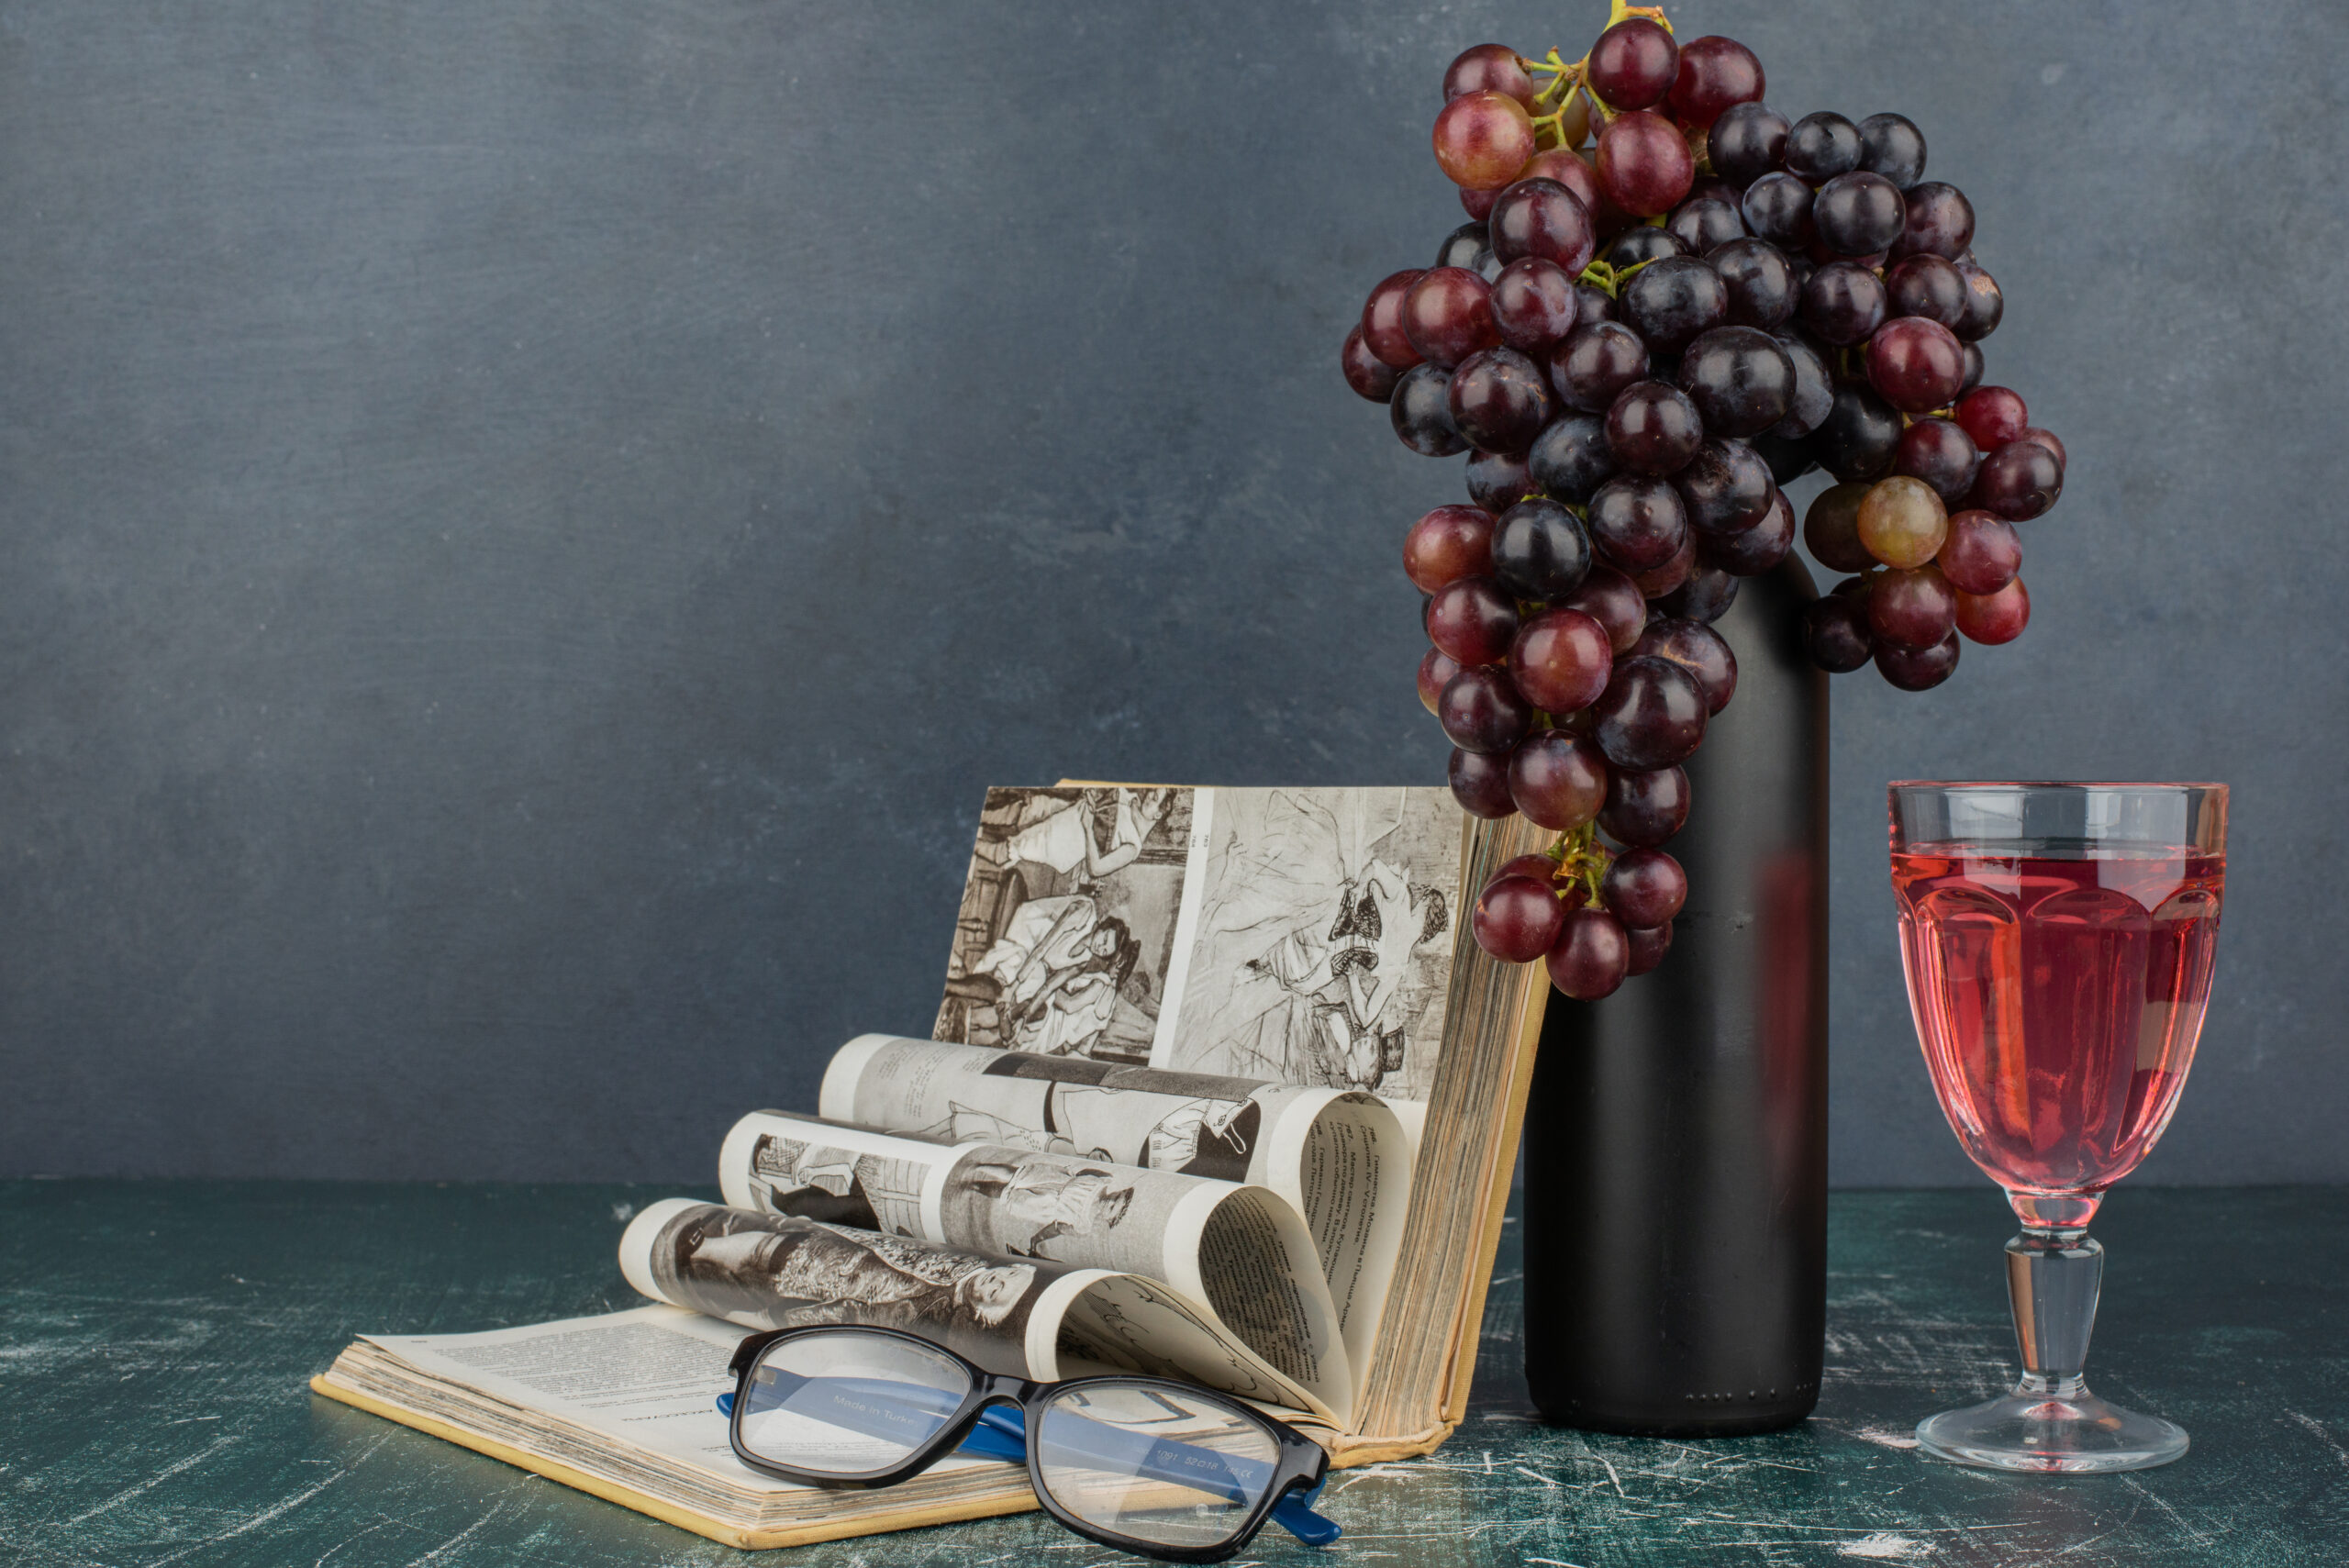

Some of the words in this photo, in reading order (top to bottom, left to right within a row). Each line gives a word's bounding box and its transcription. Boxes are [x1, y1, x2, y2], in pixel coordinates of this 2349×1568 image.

[1329, 1121, 1340, 1166] купались
[1337, 1122, 1348, 1164] Гравюра
[1345, 1123, 1354, 1141] 767.
[1368, 1126, 1377, 1145] 766.
[1330, 1167, 1340, 1205] обычно
[1341, 1165, 1348, 1177] по
[1348, 1152, 1357, 1189] Мастер
[1335, 1179, 1346, 1217] дереву.
[1321, 1206, 1335, 1244] нагими.
[1353, 1198, 1368, 1245] столетие.
[1359, 1212, 1375, 1256] Мозаика
[1326, 1227, 1338, 1256] эпоху
[1347, 1264, 1362, 1300] Пьяцца
[1278, 1240, 1291, 1272] туника
[1310, 1354, 1319, 1382] узкой
[1302, 1348, 1311, 1380] туника
[833, 1395, 866, 1412] Made
[869, 1406, 880, 1416] in
[883, 1409, 918, 1427] Turke
